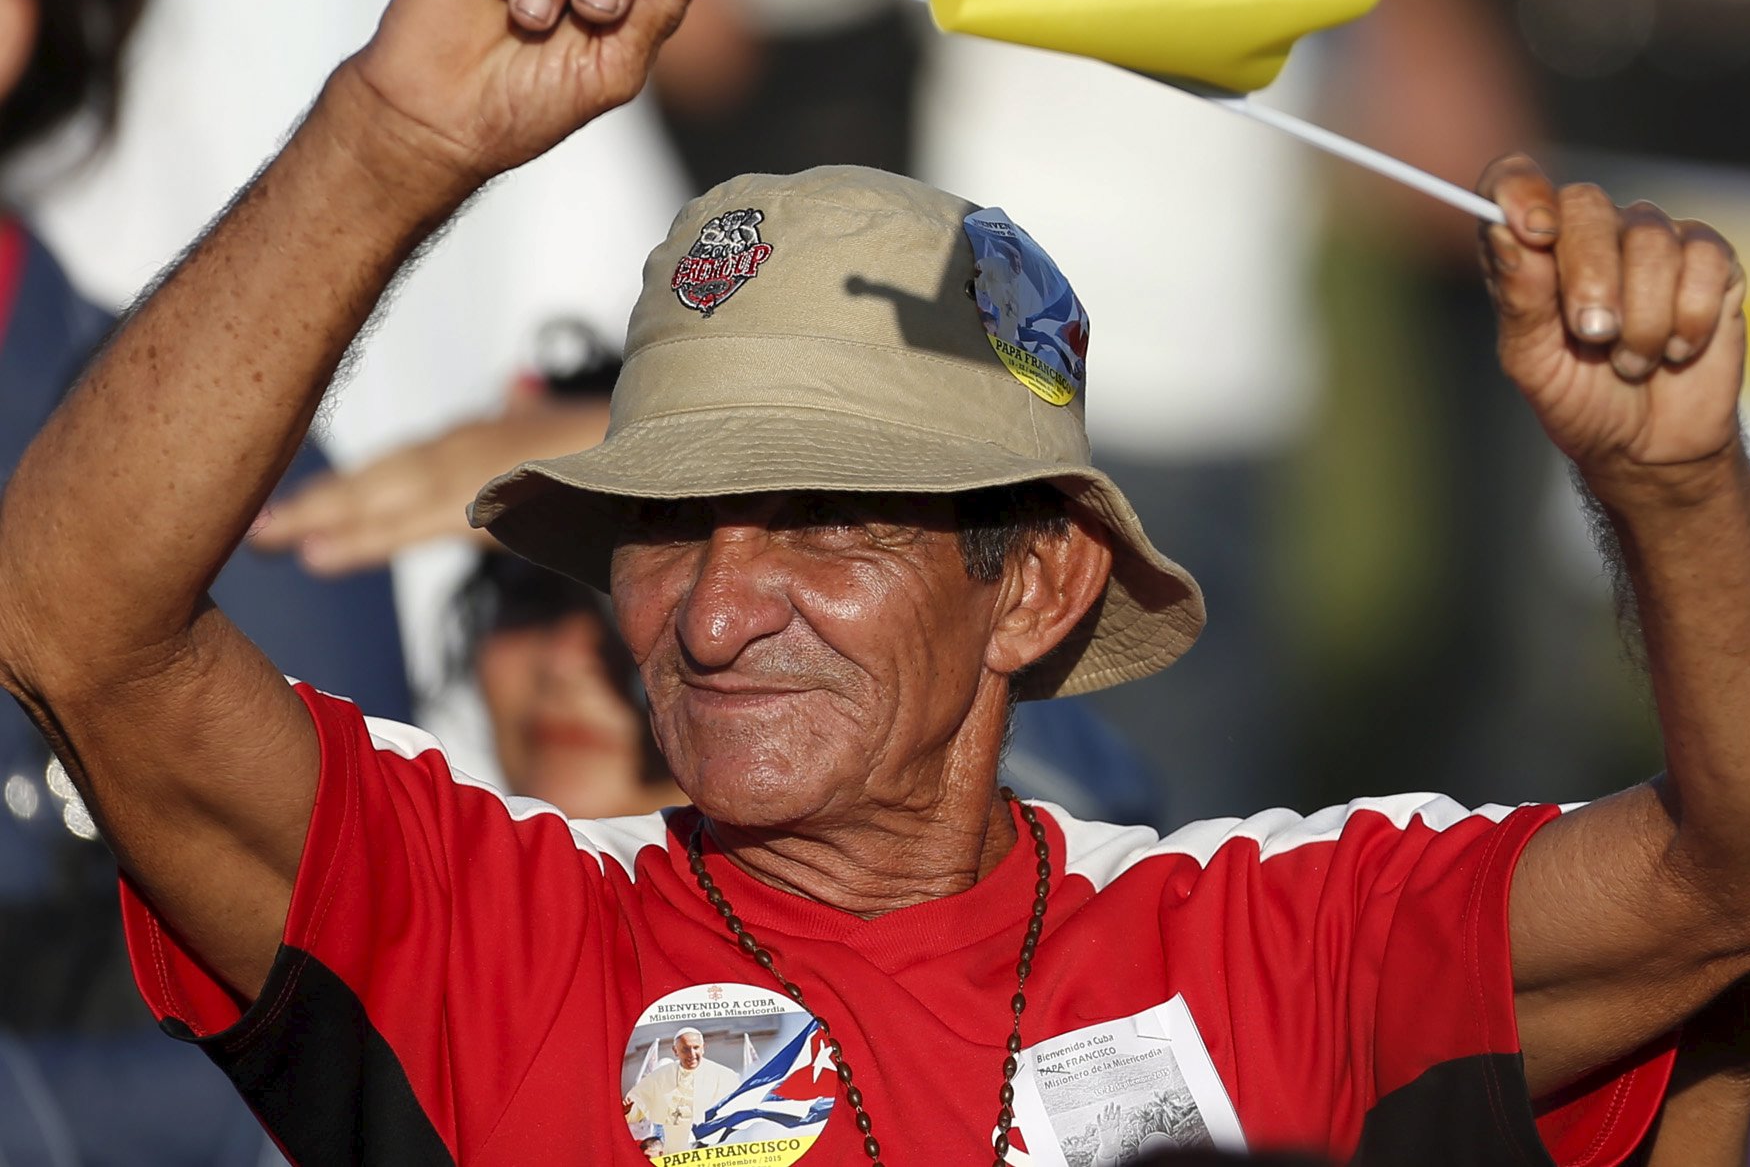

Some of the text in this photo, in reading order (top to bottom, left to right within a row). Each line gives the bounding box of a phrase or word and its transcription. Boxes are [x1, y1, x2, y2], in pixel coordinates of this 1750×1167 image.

[996, 339, 1022, 361] PAPA
[1025, 353, 1072, 394] FRANCISCO
[649, 1006, 785, 1023] Misionero de la Misericordia
[657, 998, 775, 1013] BIENVENIDO A CUBA
[1036, 1041, 1085, 1064] Bienvenido
[1093, 1034, 1114, 1045] Cuba
[1066, 1046, 1117, 1067] FRANCISCO
[1044, 1048, 1163, 1090] Misionero de la Misericordia
[663, 1139, 801, 1167] PAPA FRANCISCO
[764, 1155, 782, 1163] 2015
